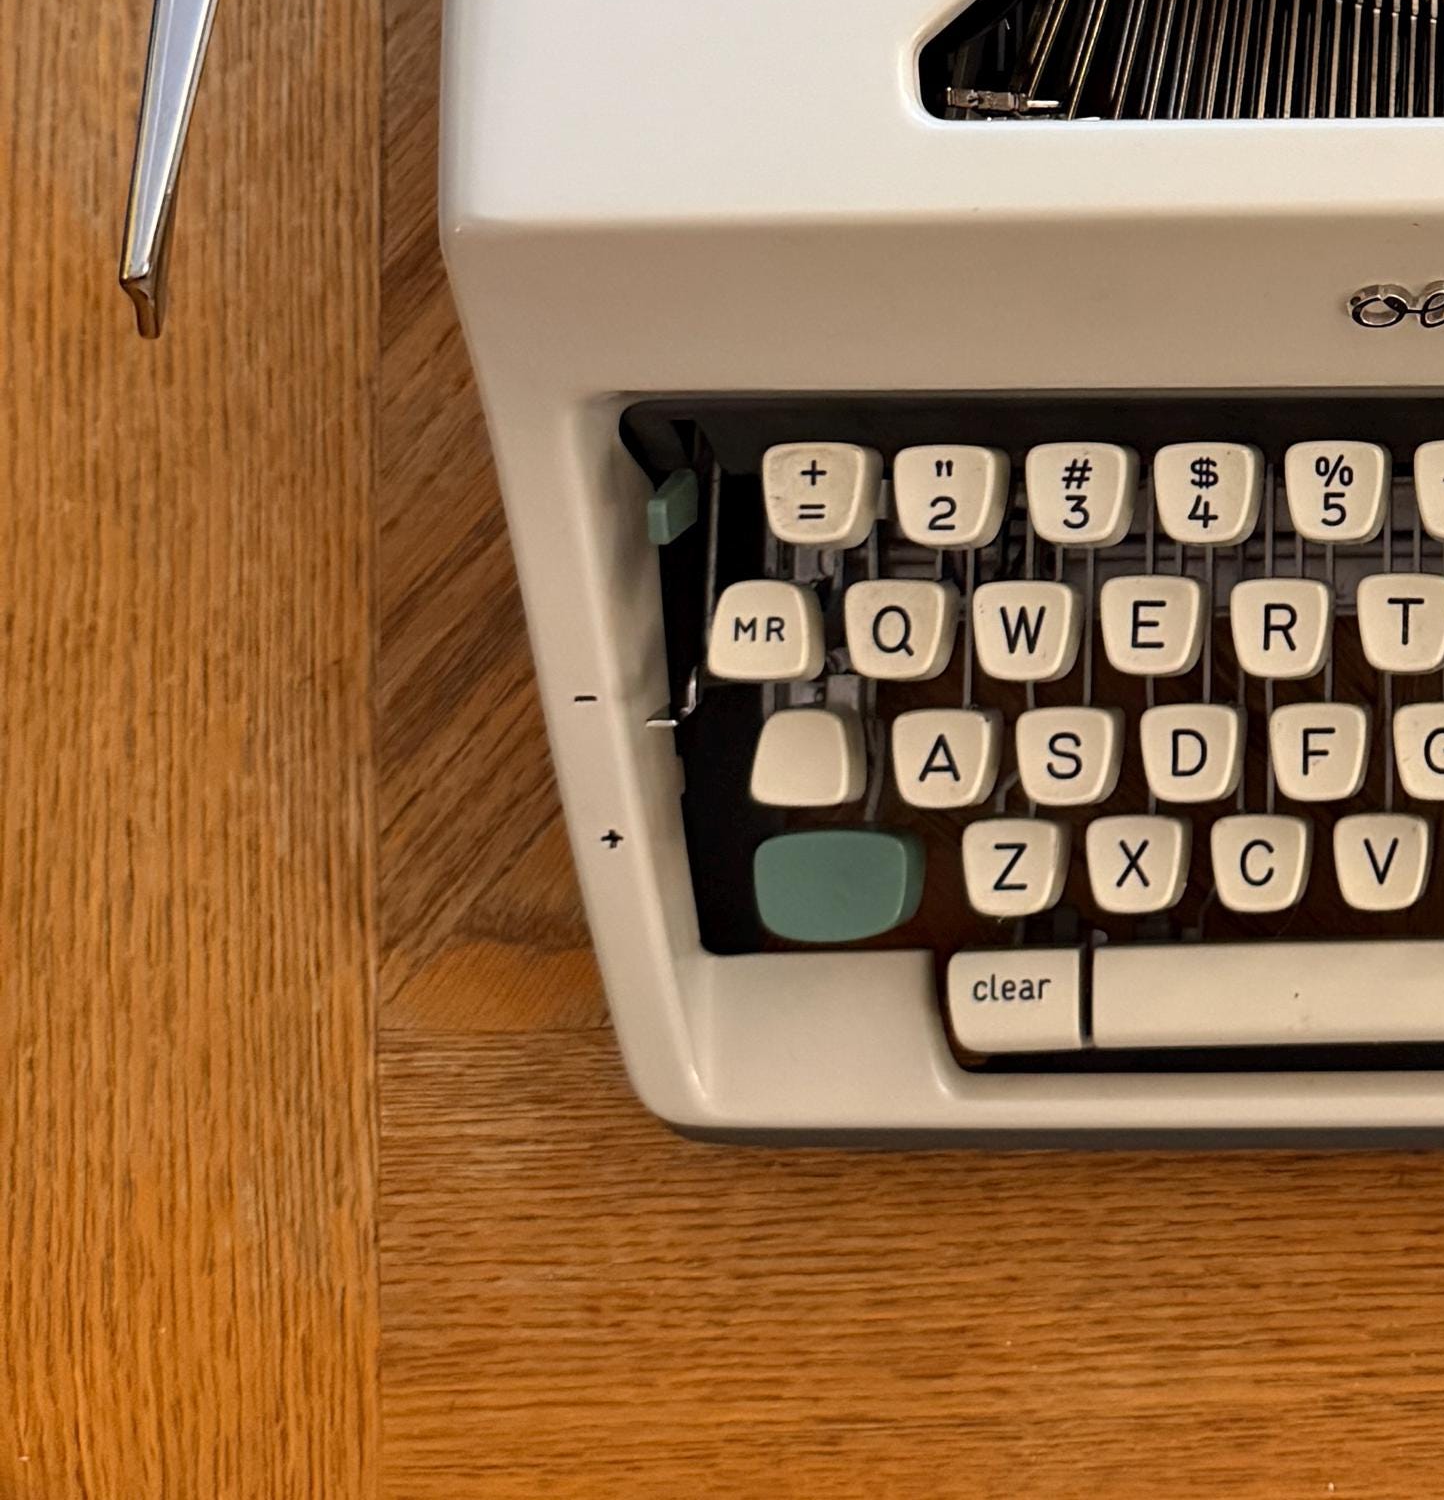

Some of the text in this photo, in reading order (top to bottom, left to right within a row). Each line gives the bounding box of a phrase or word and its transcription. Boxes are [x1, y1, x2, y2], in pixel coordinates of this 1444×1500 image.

[1060, 457, 1094, 491] #
[1189, 455, 1220, 490] $
[1314, 453, 1355, 489] %
[926, 494, 958, 532] 2
[1061, 493, 1091, 531] 3
[1186, 493, 1220, 530] 4
[1320, 490, 1348, 528] 5
[733, 615, 786, 643] MR
[871, 604, 915, 658] Q
[998, 604, 1047, 656] W
[1130, 599, 1168, 650] E
[1262, 602, 1299, 653] R
[1386, 596, 1426, 647] T
[917, 733, 962, 783] A
[1045, 730, 1084, 781] S
[1170, 727, 1209, 778] D
[1301, 726, 1337, 777] F
[992, 841, 1029, 892] Z
[1115, 838, 1151, 889] X
[1238, 838, 1276, 888] C
[1362, 836, 1400, 886] V
[971, 972, 1053, 1003] clear
